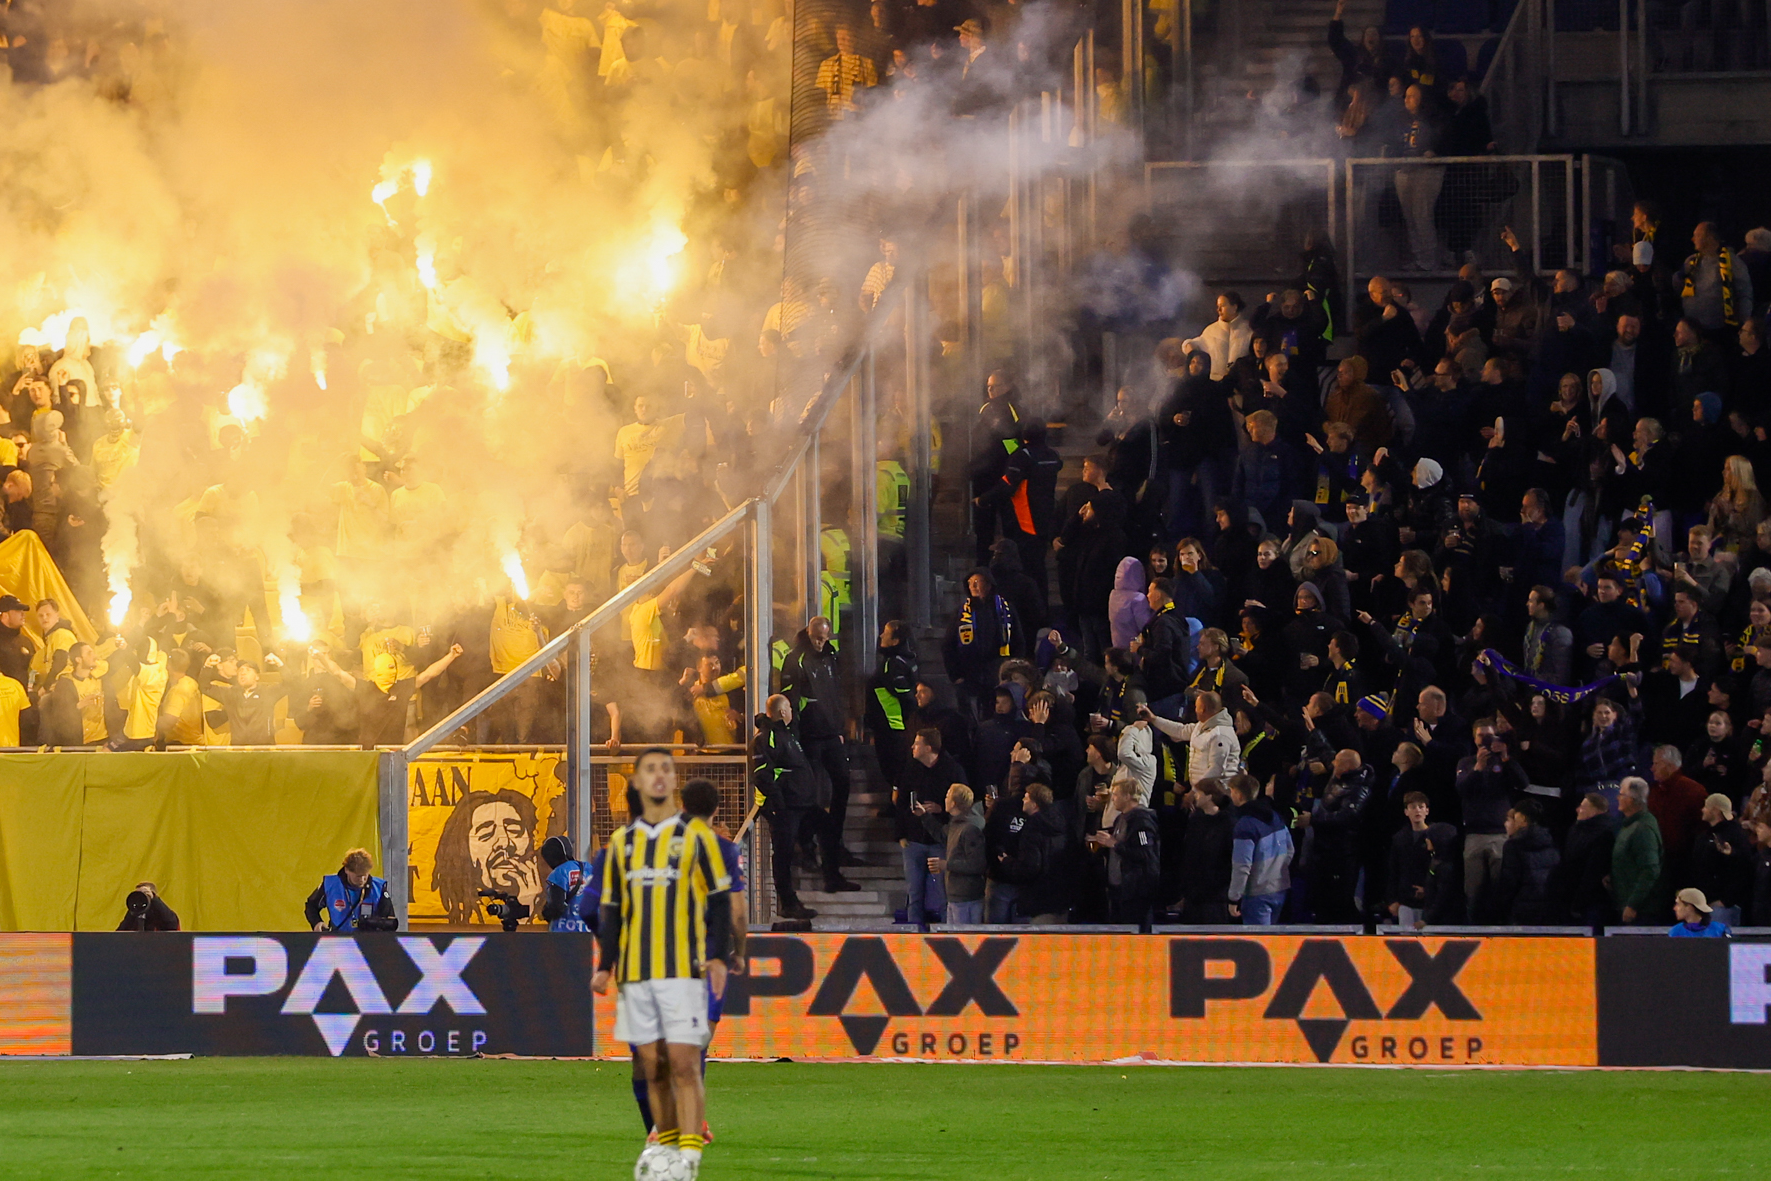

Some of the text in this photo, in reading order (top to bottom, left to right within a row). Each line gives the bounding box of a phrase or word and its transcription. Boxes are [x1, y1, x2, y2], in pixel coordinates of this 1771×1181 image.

[411, 766, 472, 807] AAN
[192, 935, 487, 1015] PAX
[721, 935, 1019, 1017] PAX
[1170, 938, 1482, 1021] PAX
[364, 1030, 488, 1054] GROEP
[893, 1032, 1020, 1056] GROEP
[1352, 1036, 1484, 1061] GROEP
